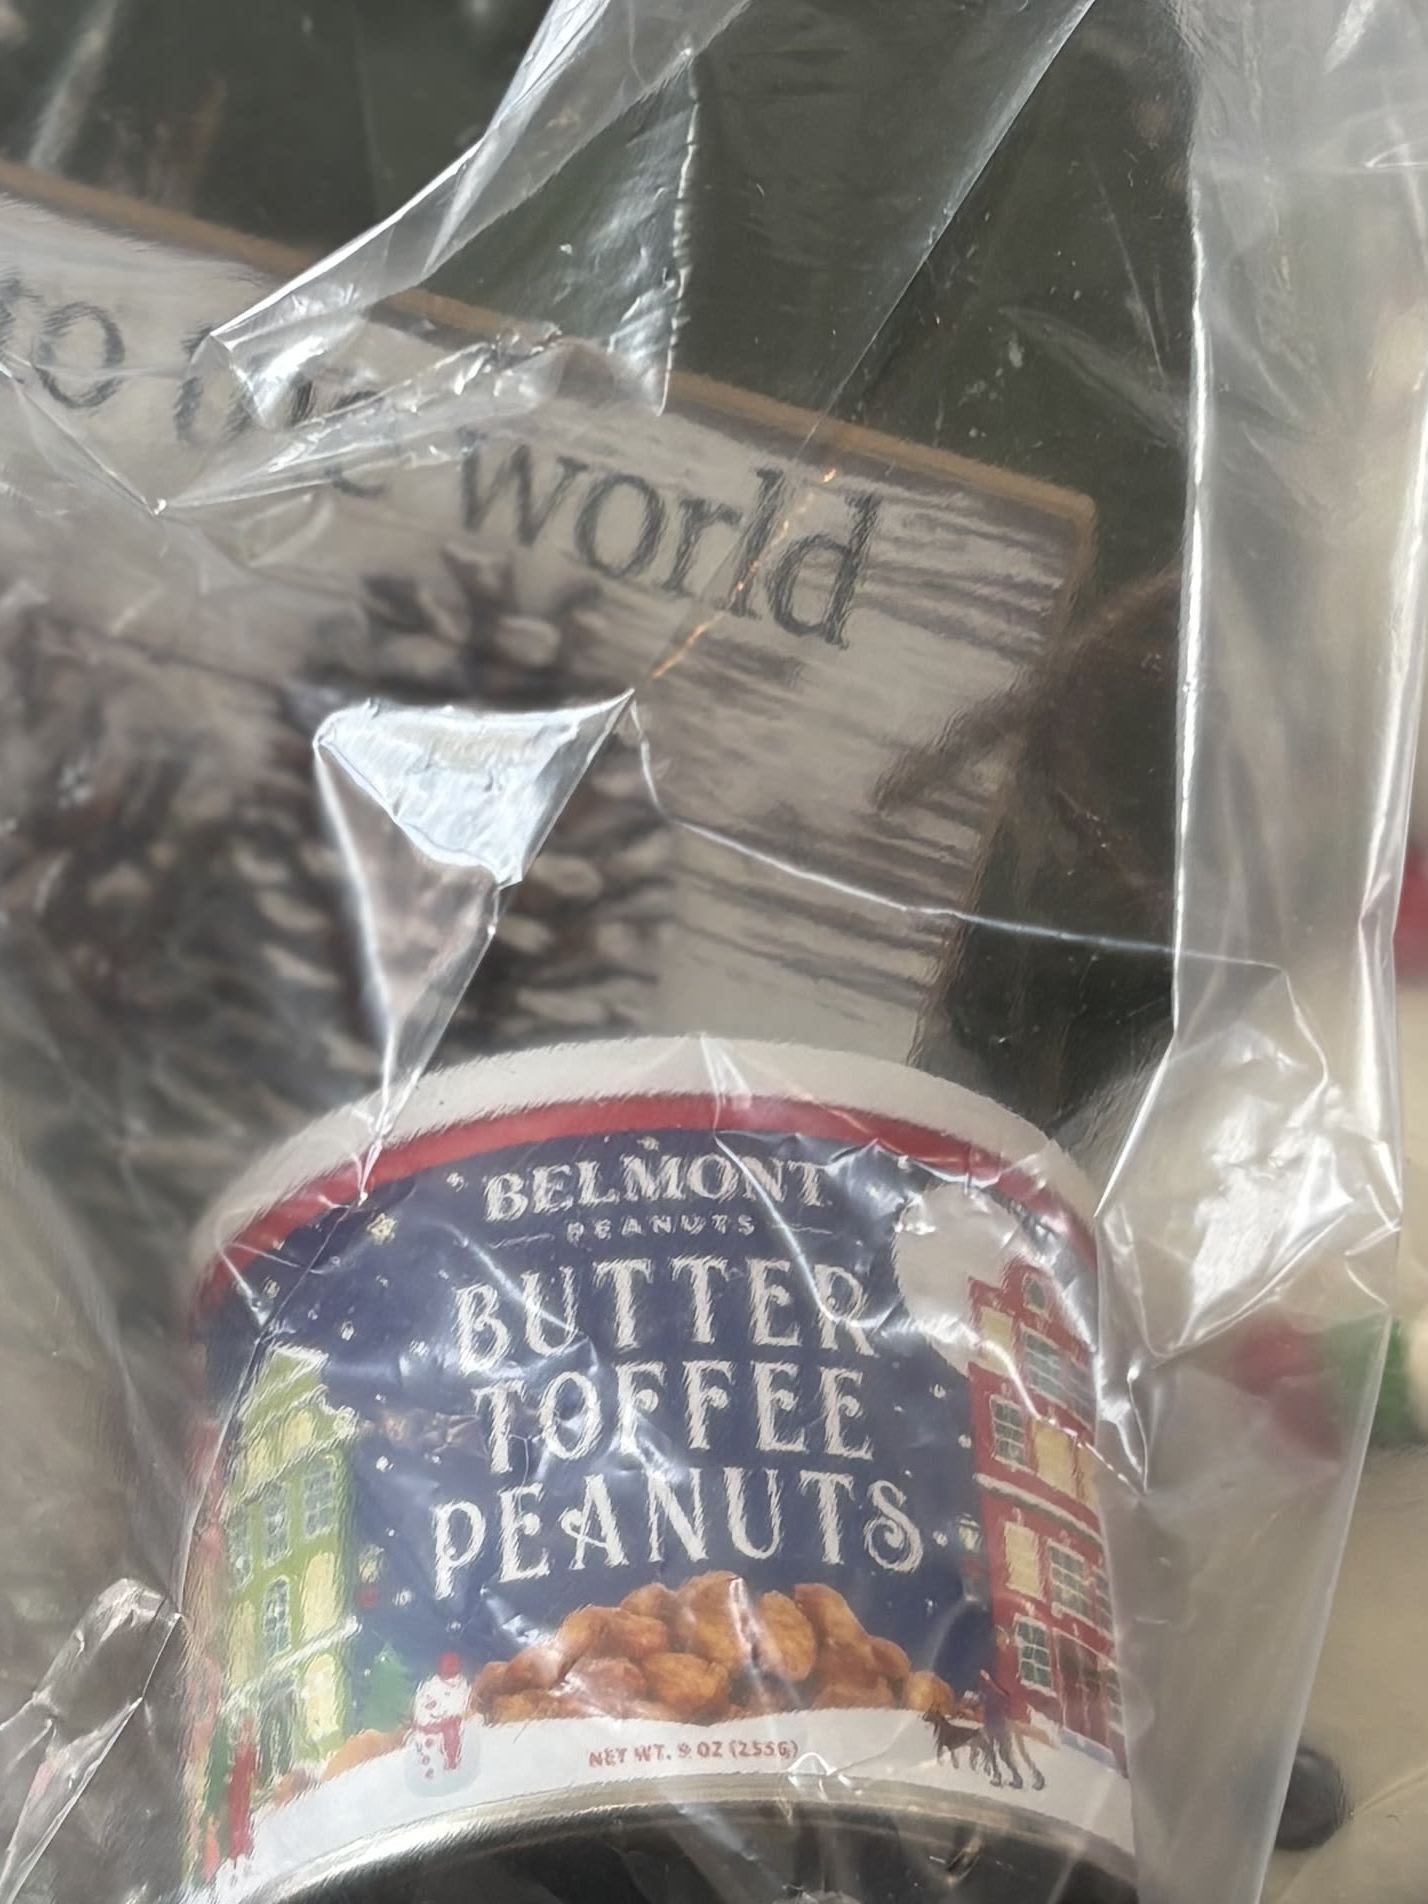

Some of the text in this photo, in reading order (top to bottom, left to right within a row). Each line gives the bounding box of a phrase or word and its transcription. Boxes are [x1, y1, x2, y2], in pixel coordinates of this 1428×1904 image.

[457, 426, 880, 649] world
[483, 1152, 832, 1223] BELMONT
[567, 1213, 757, 1248] PEANUTS
[452, 1254, 876, 1376] BUTTER
[472, 1360, 873, 1474] TOFFEE
[431, 1466, 925, 1600] PEANUTS
[588, 1747, 628, 1768] NET
[633, 1743, 672, 1762] WT.
[696, 1740, 723, 1759] OZ
